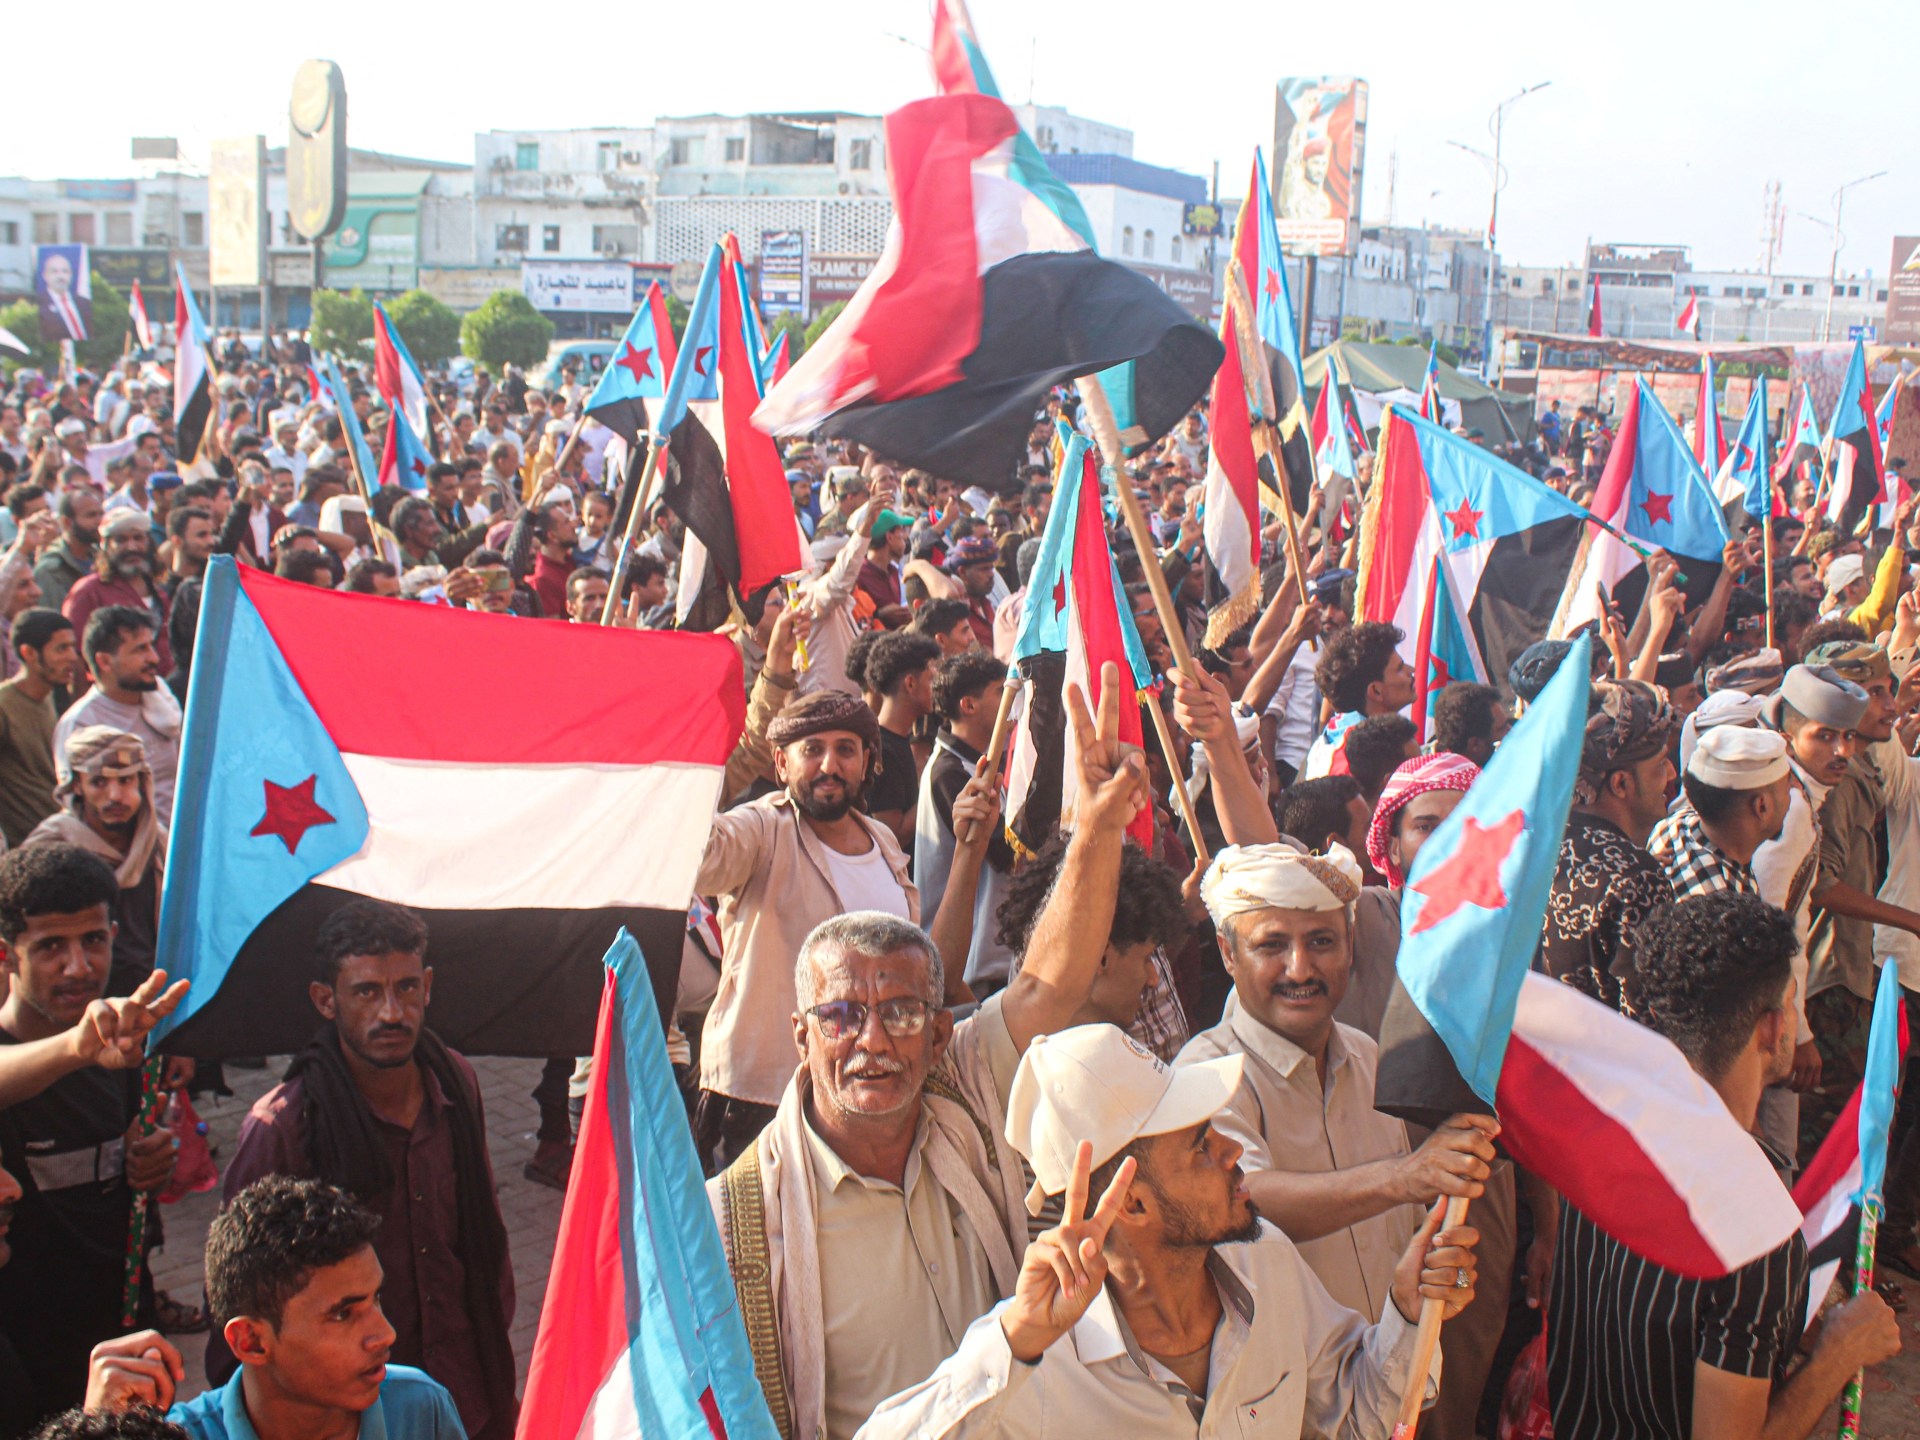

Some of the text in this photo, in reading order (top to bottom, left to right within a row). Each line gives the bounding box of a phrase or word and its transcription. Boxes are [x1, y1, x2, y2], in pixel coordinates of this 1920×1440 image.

[809, 261, 856, 277] SLAMIC
[858, 262, 876, 278] BA
[537, 273, 580, 293] للتجارة
[584, 276, 628, 296] باعبيد
